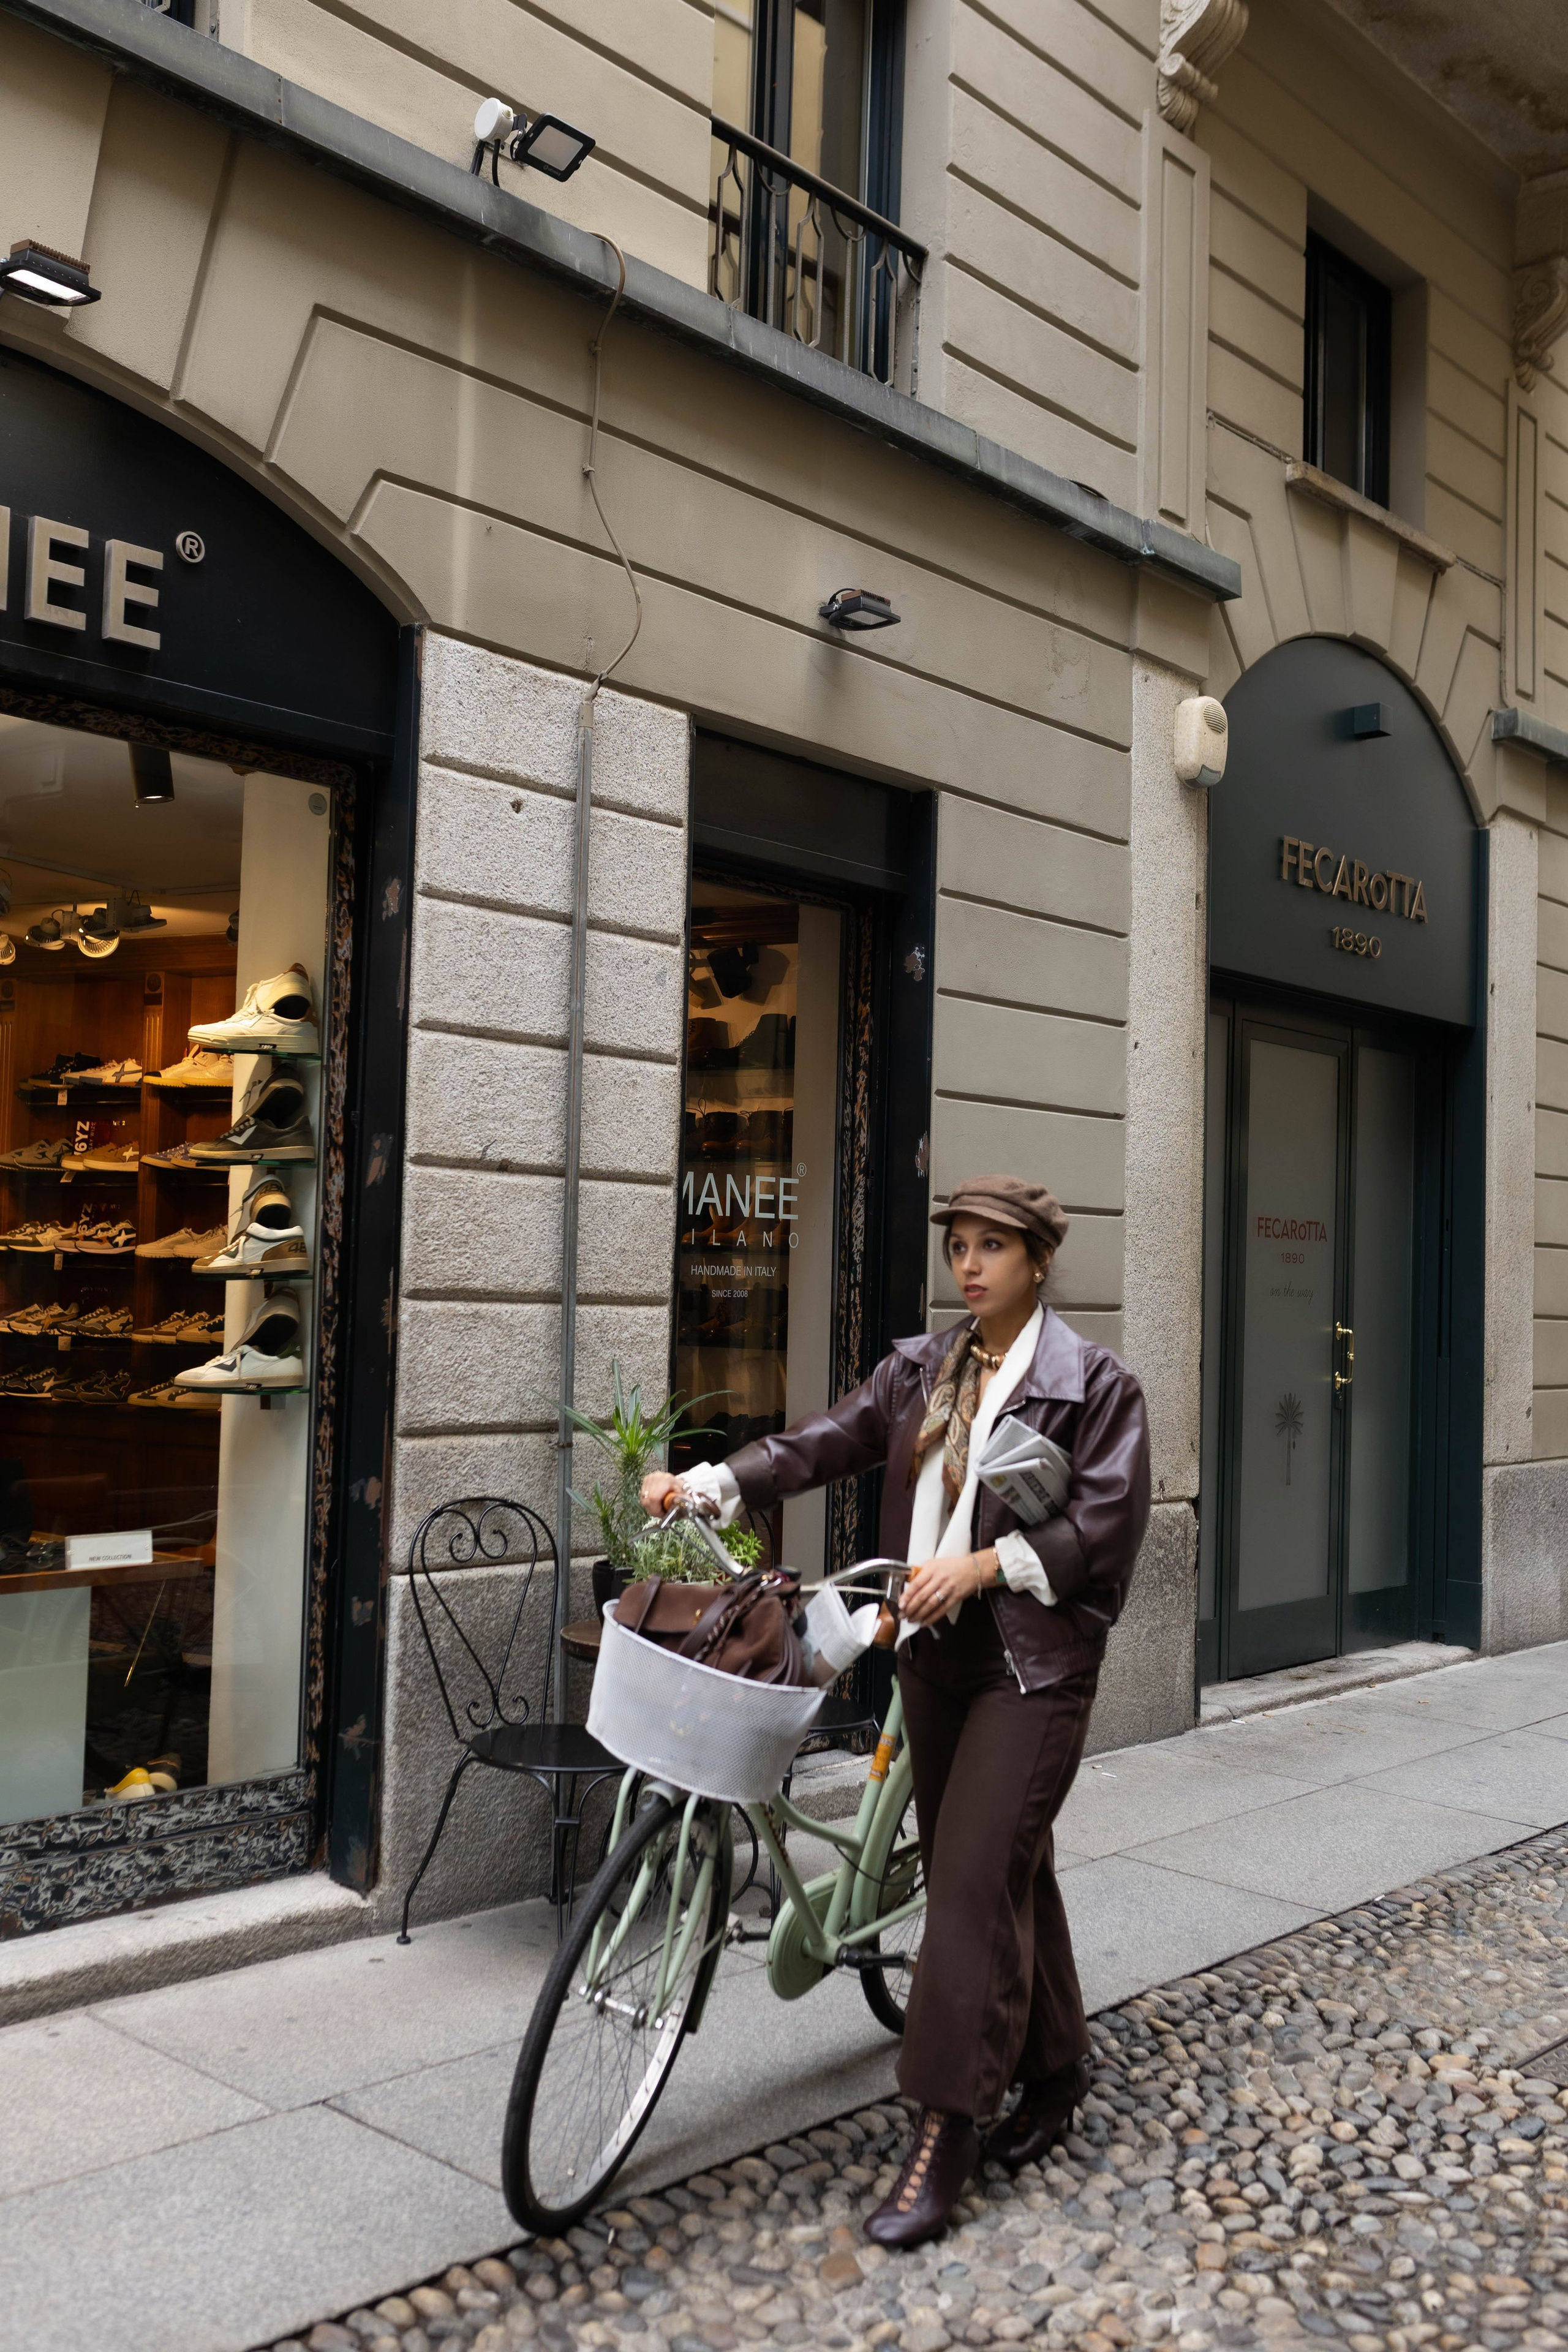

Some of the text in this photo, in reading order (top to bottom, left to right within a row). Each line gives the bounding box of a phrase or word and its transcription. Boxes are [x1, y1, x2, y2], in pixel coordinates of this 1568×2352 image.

[1331, 926, 1382, 959] 1890
[1281, 1252, 1305, 1264] 1890
[690, 1264, 777, 1277] HANDMADE IN ITALY
[711, 1289, 732, 1298] SINCE
[1270, 1280, 1314, 1305] on the way
